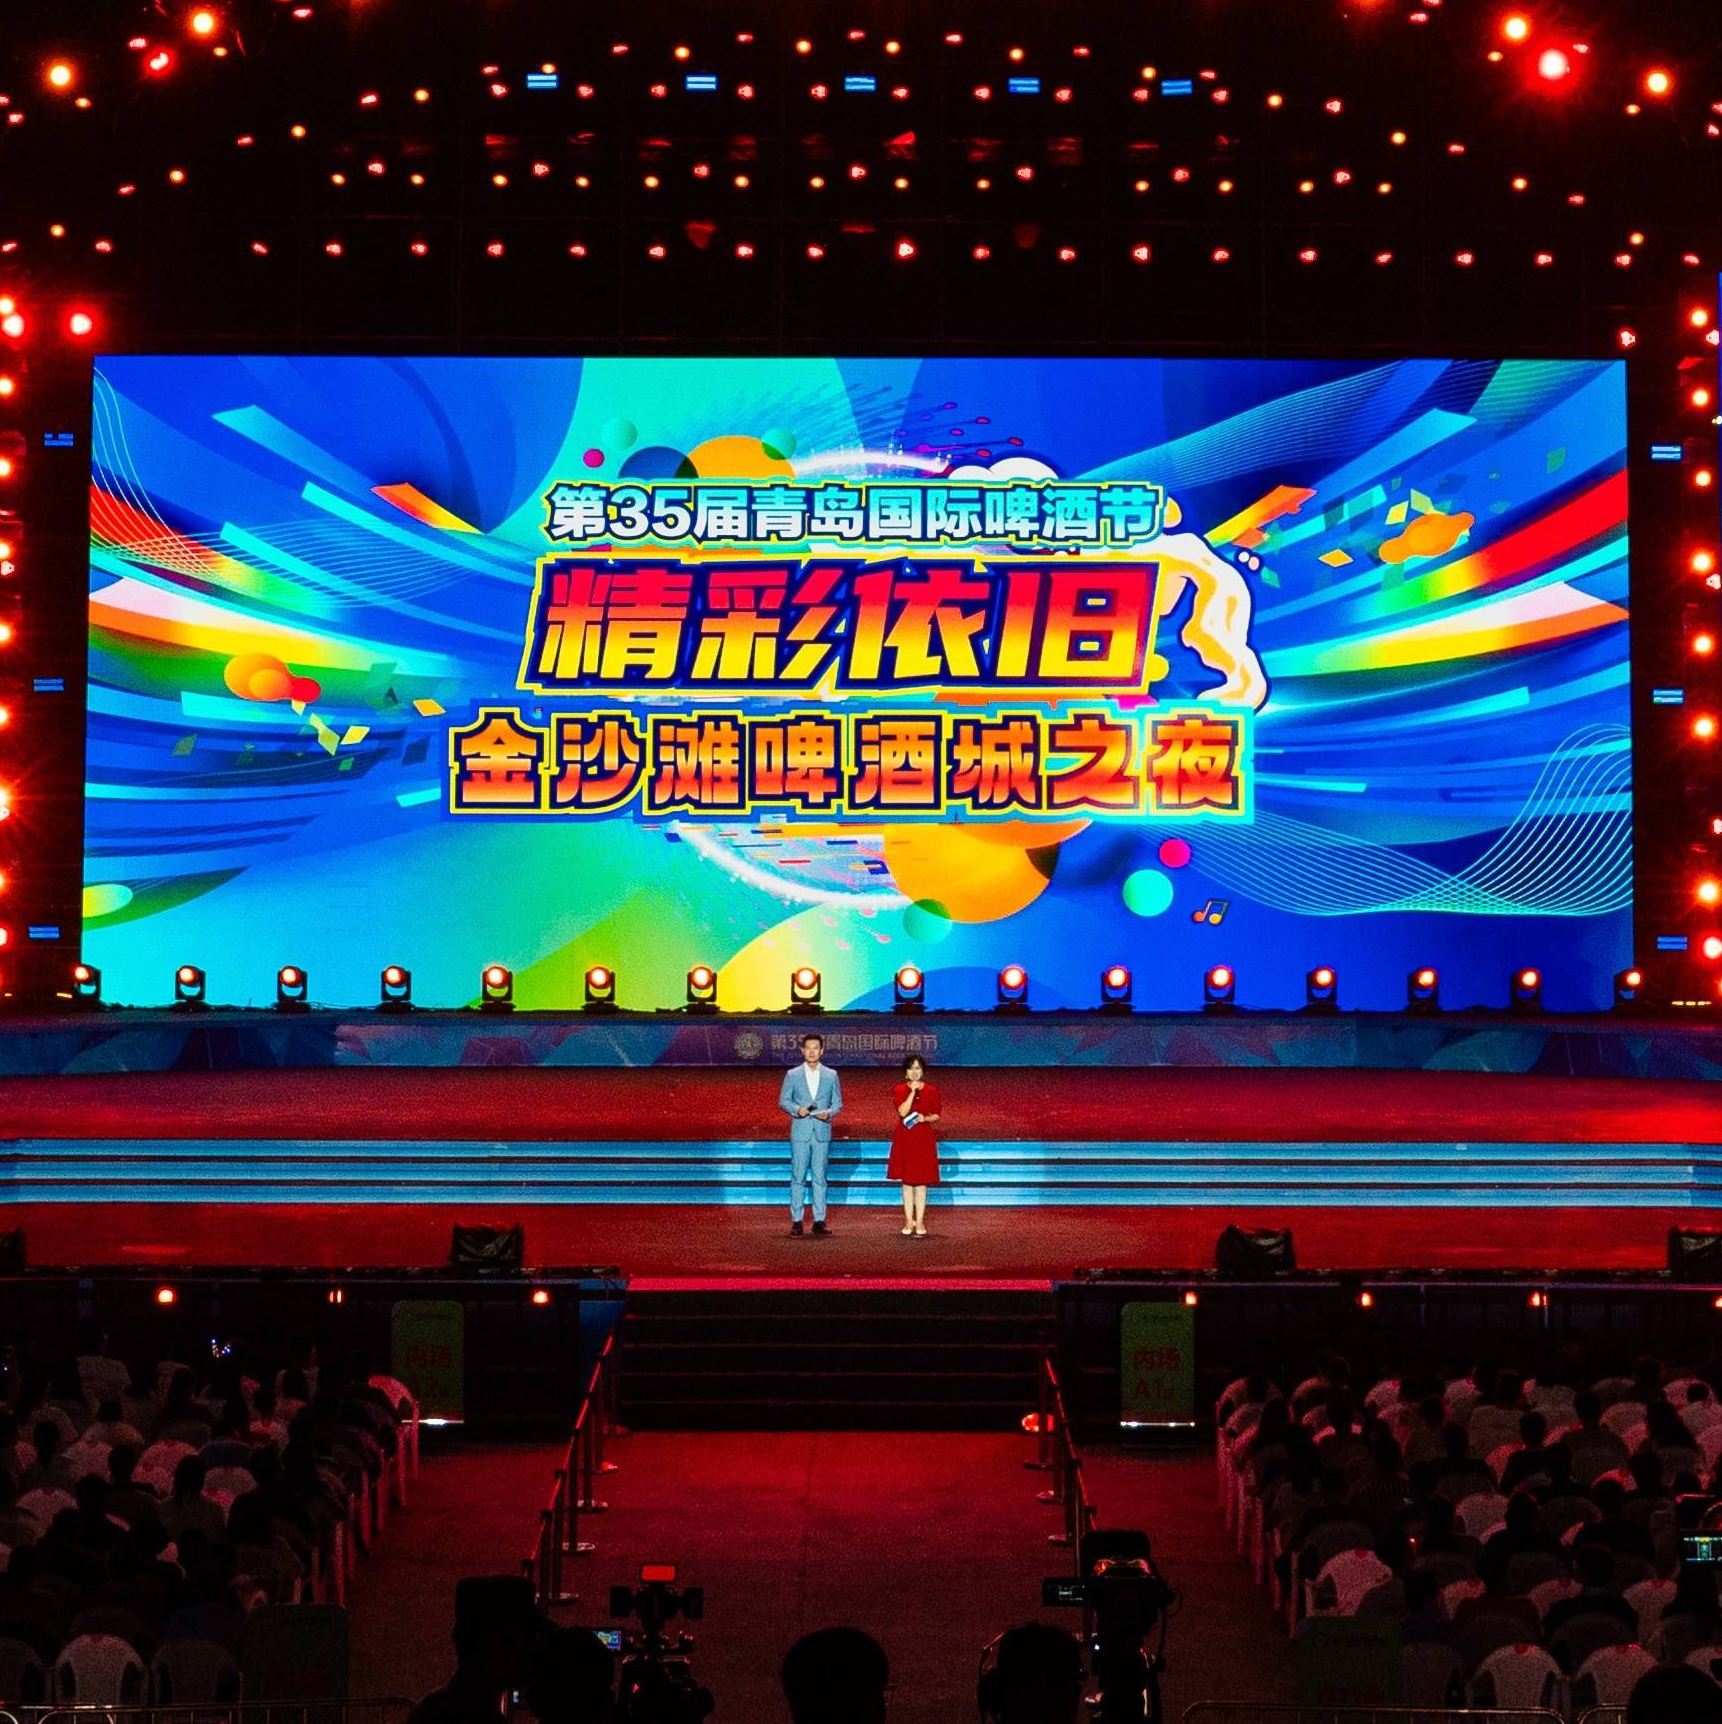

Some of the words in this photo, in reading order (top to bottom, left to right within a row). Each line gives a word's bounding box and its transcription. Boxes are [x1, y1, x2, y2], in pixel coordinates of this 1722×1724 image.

[549, 484, 1160, 541] 第35届青岛国际啤酒节
[541, 563, 1153, 681] 精彩依旧
[459, 716, 1239, 806] 金沙滩啤酒城之夜
[771, 1033, 938, 1051] 第35青岛国际啤酒节
